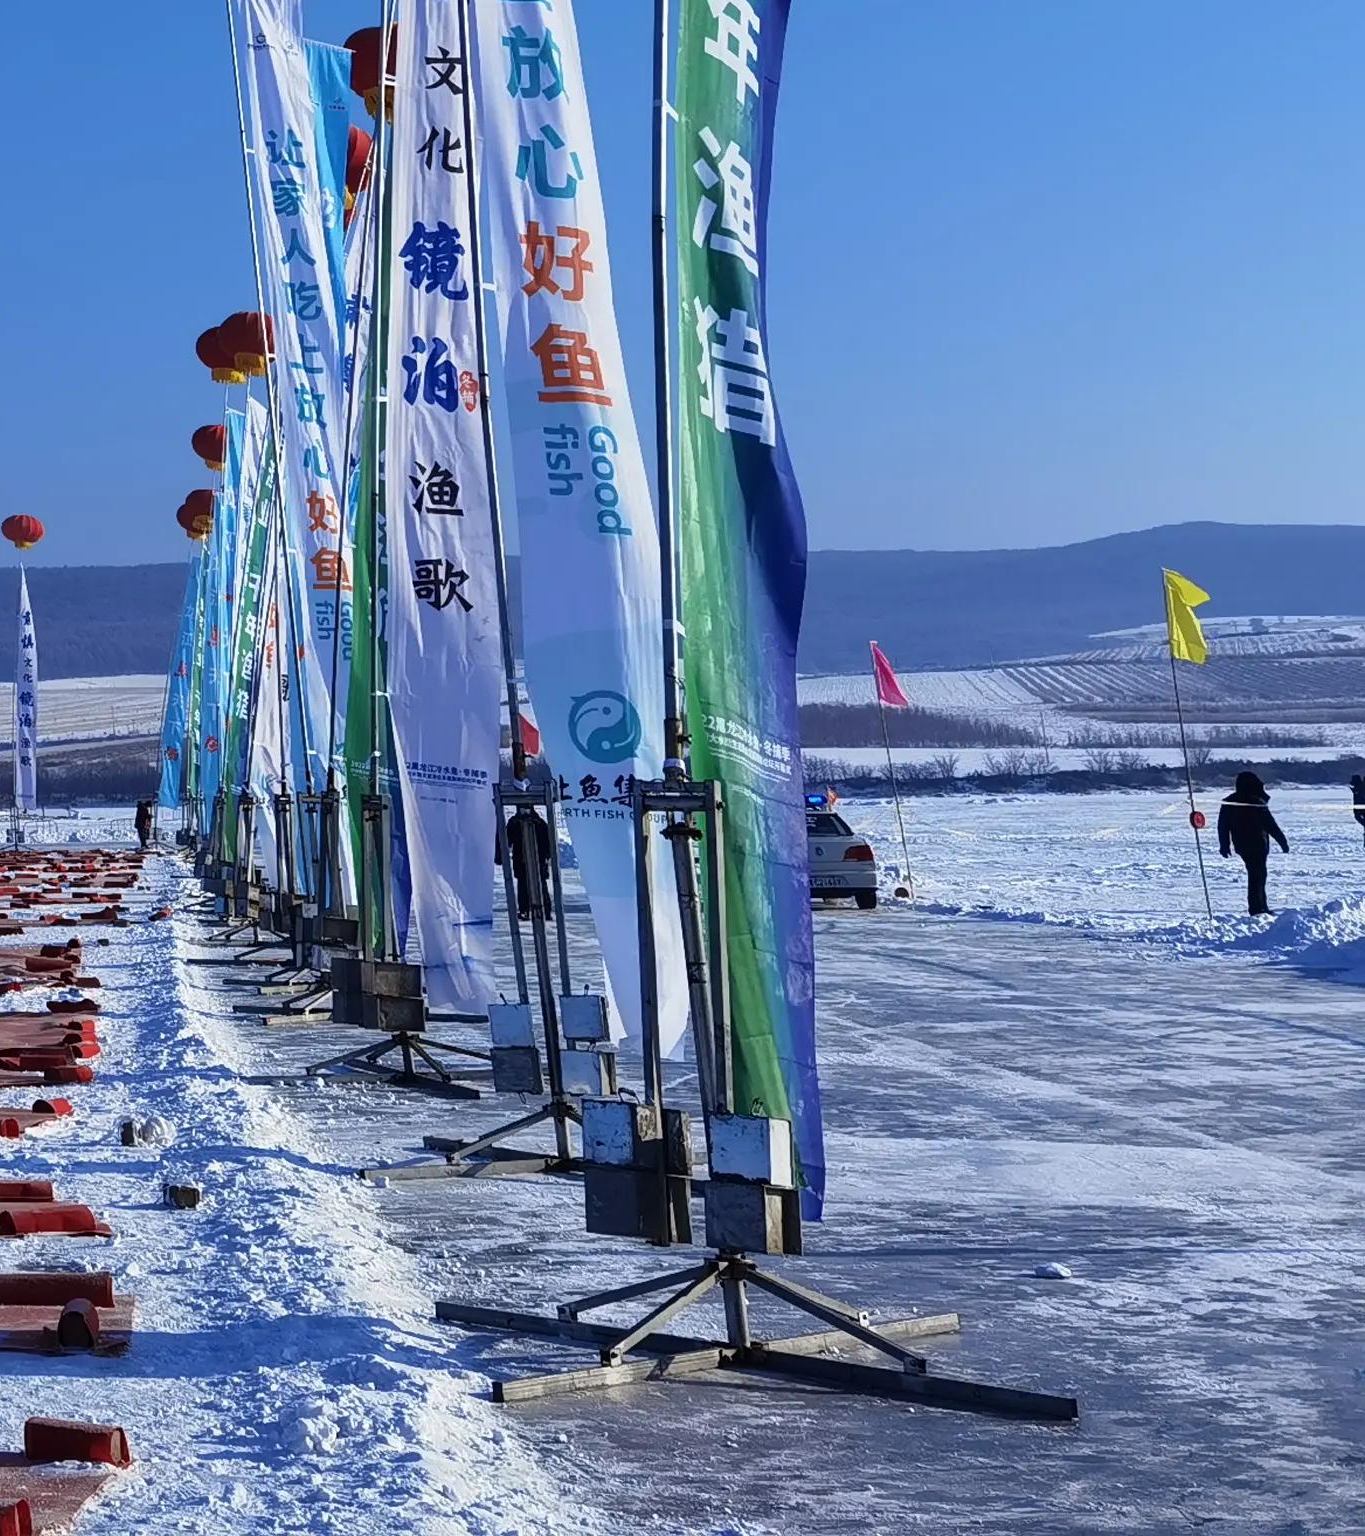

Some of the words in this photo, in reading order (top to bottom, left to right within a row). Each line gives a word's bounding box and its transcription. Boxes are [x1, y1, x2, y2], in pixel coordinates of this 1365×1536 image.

[542, 423, 582, 497] fish
[587, 424, 632, 537] Good
[594, 809, 625, 820] FISH
